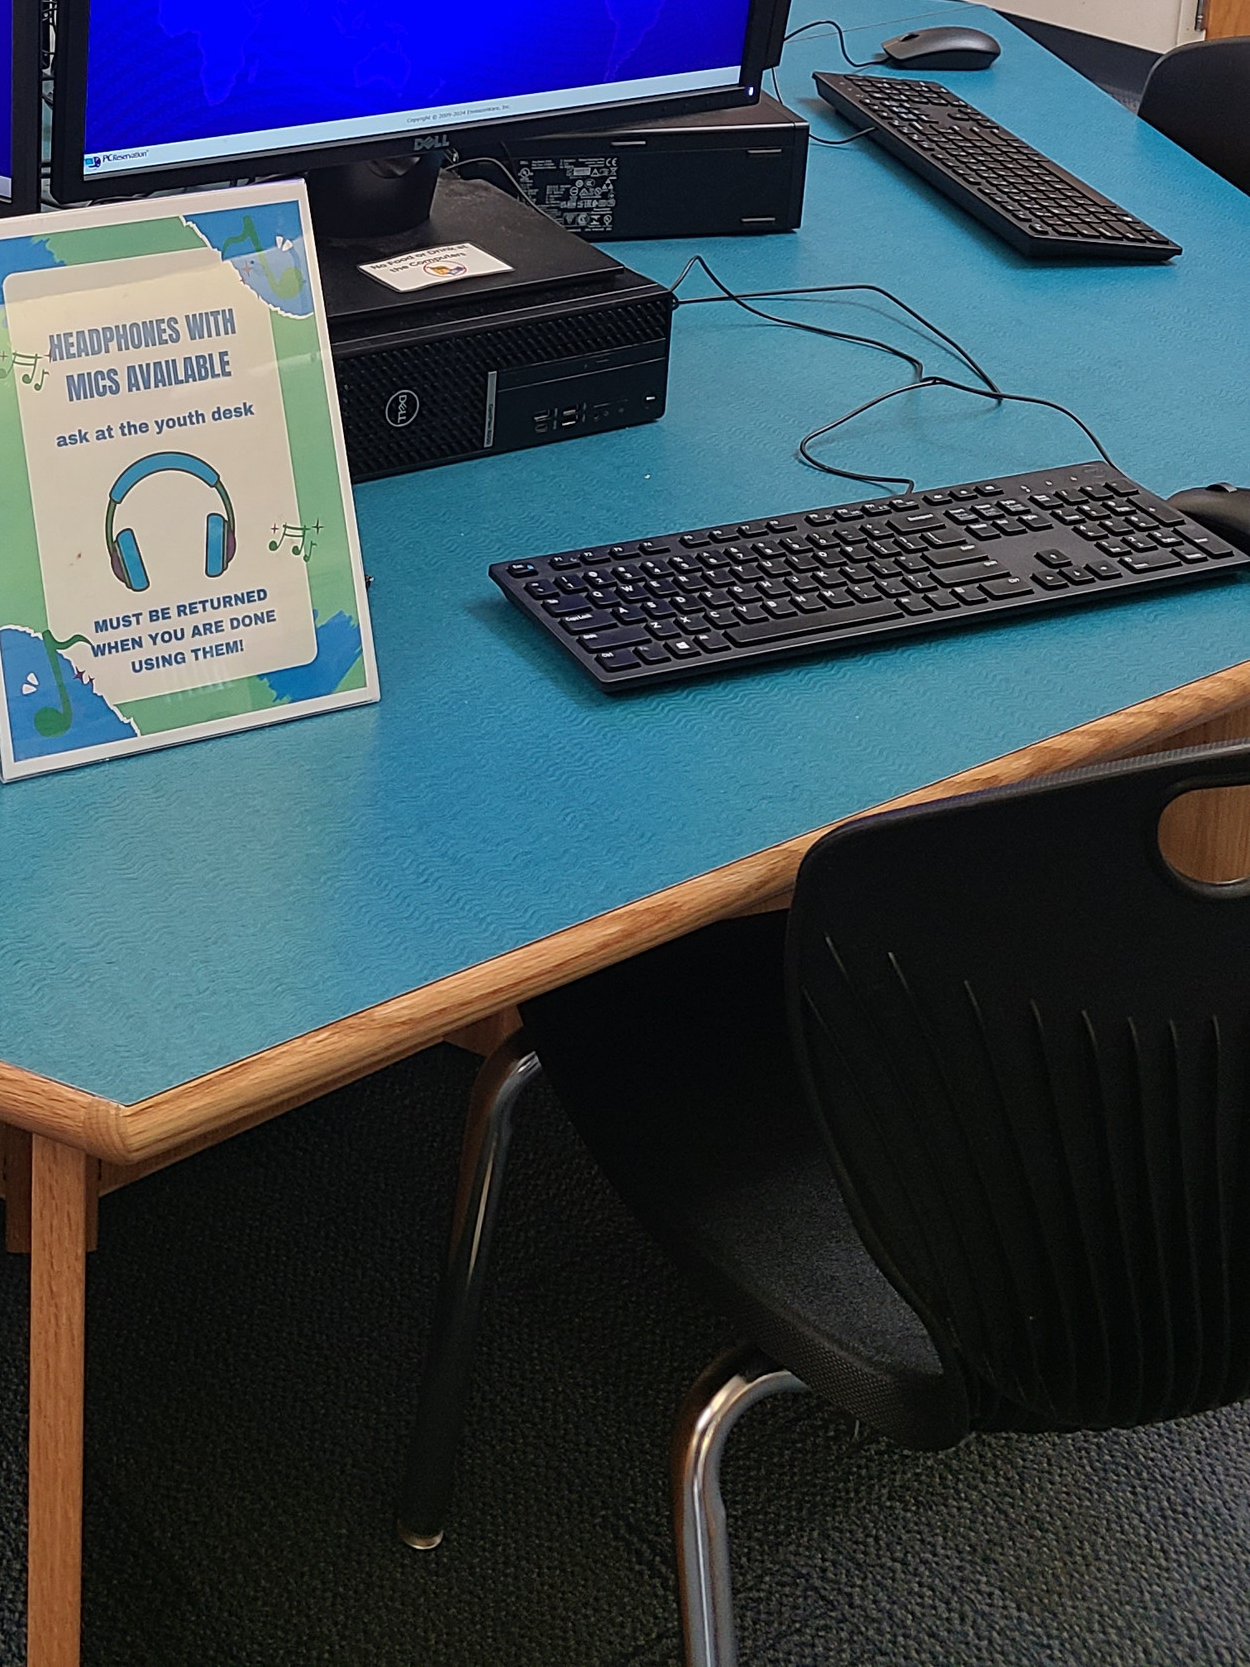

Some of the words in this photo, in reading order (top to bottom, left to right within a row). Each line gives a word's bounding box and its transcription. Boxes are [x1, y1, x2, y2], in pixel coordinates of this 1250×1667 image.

[413, 135, 450, 151] DELL
[388, 255, 414, 266] Food
[427, 246, 455, 256] Drink
[390, 265, 409, 273] the
[409, 252, 467, 267] Computers
[49, 316, 180, 362] HEADPHONES
[185, 308, 237, 338] WITH
[66, 370, 120, 402] MICS
[127, 351, 232, 393] AVAILABLE
[56, 427, 90, 448] ask
[95, 422, 115, 441] at
[119, 417, 149, 438] the
[154, 410, 207, 438] youth
[211, 402, 255, 424] desk
[397, 395, 407, 423] DELL
[94, 611, 144, 633] MUST
[149, 606, 171, 624] BE
[176, 587, 268, 619] RETURNED
[91, 635, 145, 658] WHEN
[148, 627, 186, 647] YOU
[191, 620, 225, 640] ARE
[230, 608, 277, 631] DONE
[131, 650, 188, 674] USING
[192, 639, 245, 663] THEM!
